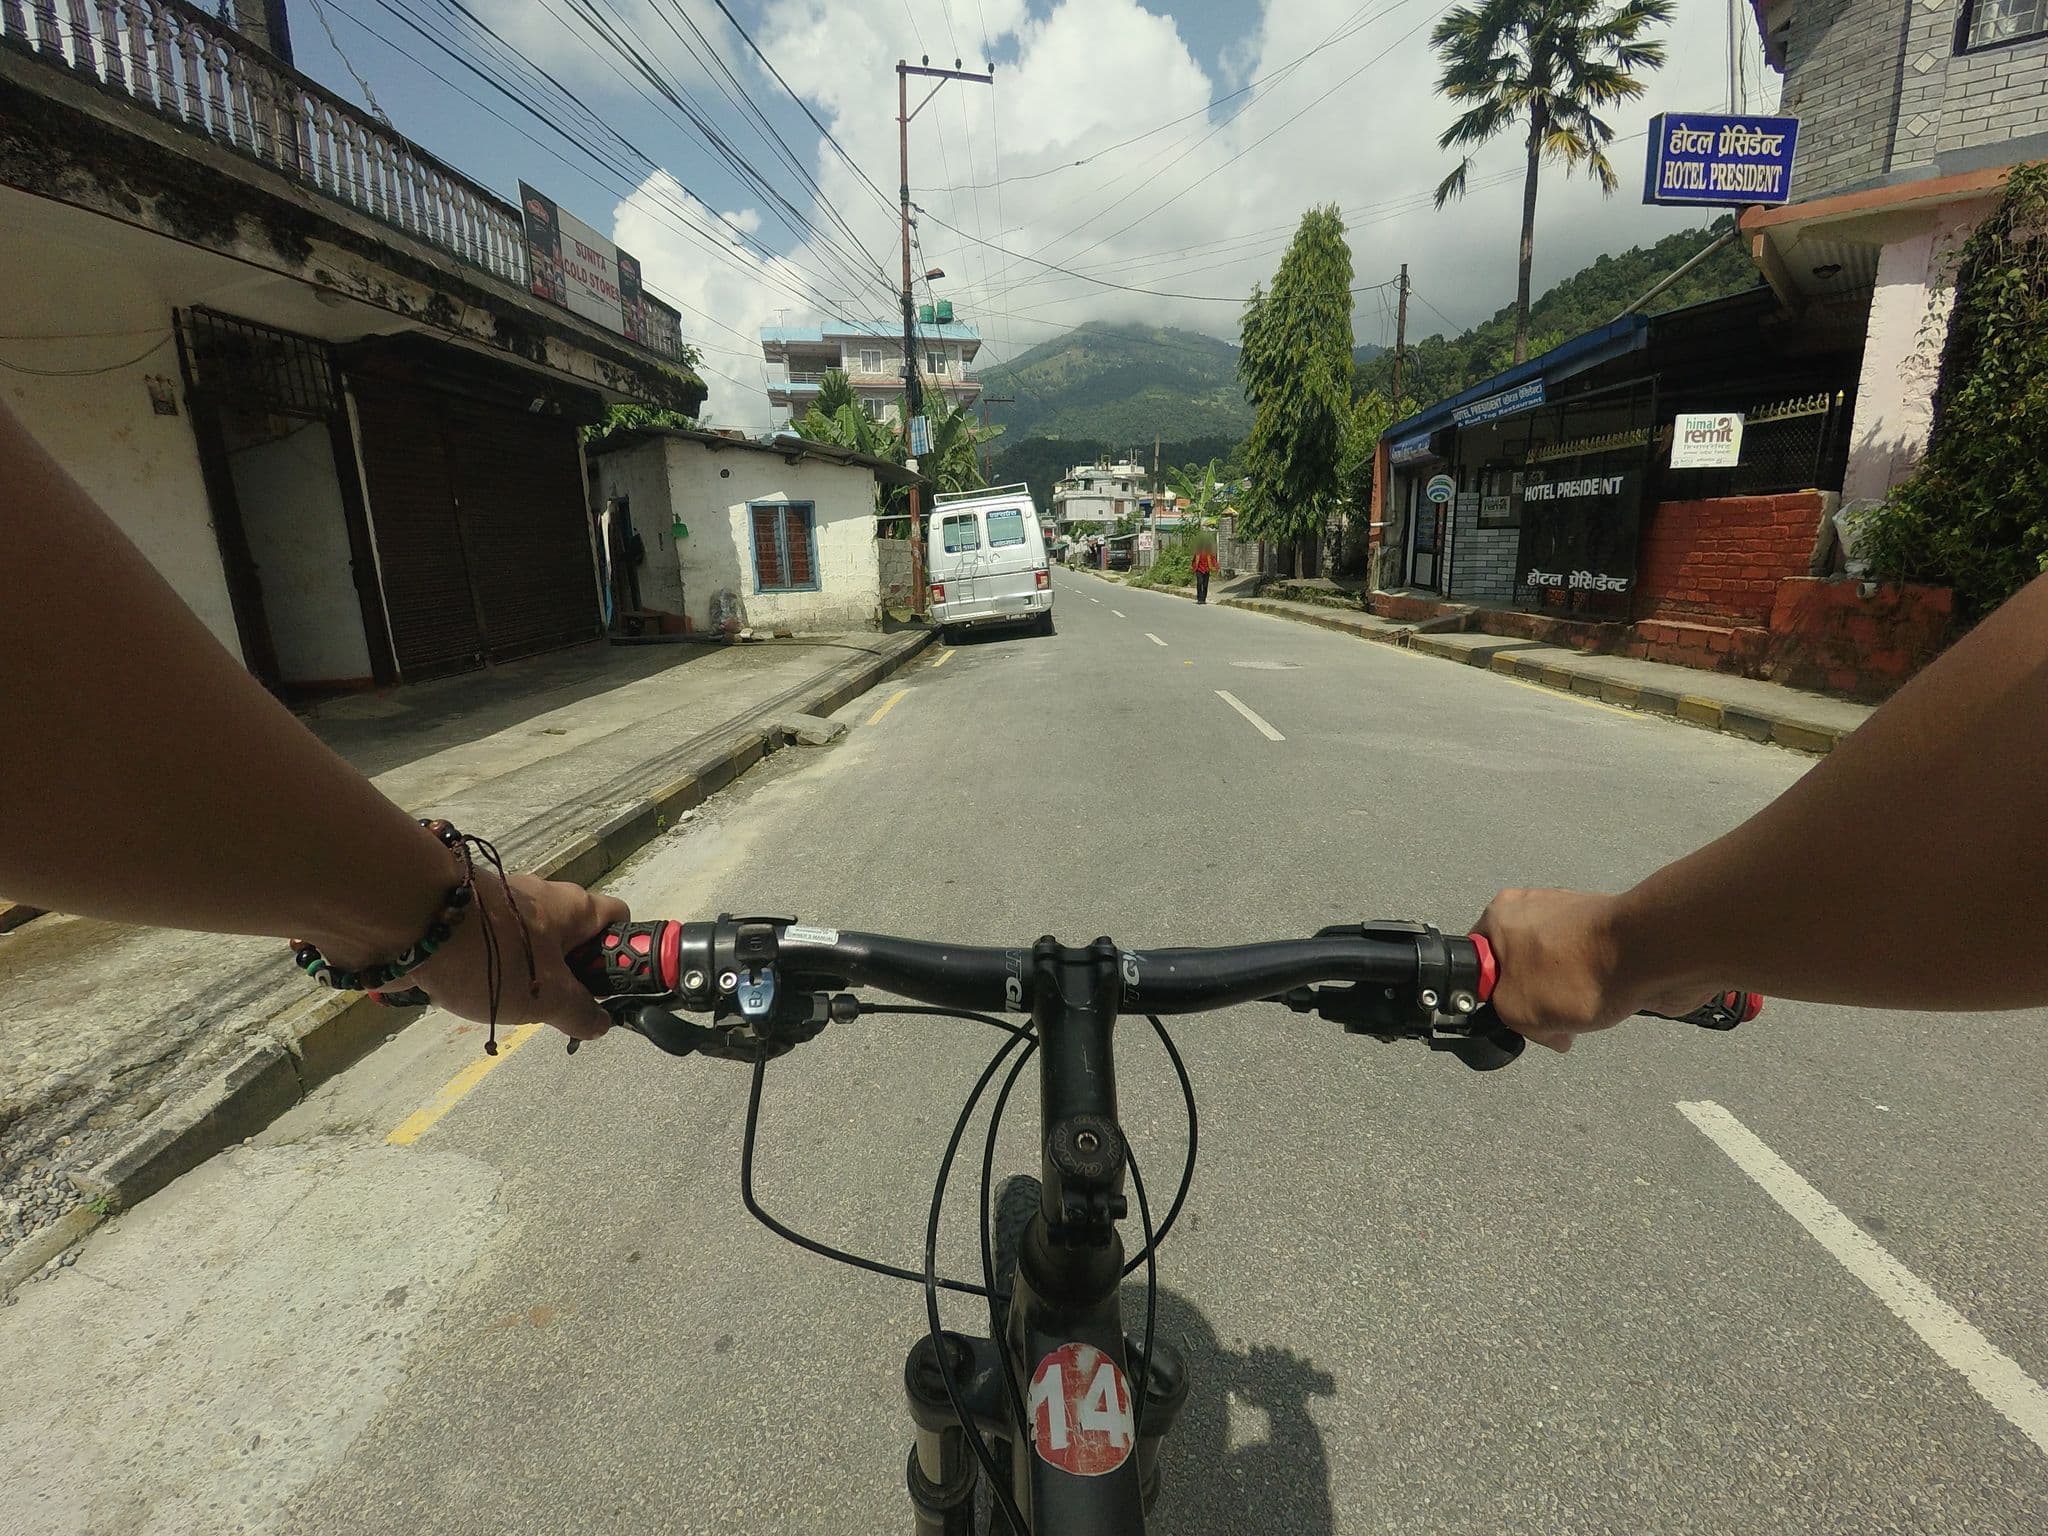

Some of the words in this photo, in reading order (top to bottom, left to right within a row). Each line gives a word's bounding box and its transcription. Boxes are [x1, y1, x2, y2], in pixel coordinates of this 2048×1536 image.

[1669, 122, 1715, 155] होटल
[1718, 123, 1785, 158] प्रेसिडेन्ट
[1663, 160, 1707, 190] HOTEL
[1709, 163, 1783, 193] PRESIDENT
[575, 241, 607, 273] SUNITA
[564, 258, 588, 284] COLD
[589, 273, 621, 302] STORES
[1471, 398, 1502, 415] PRESIDENT
[1684, 423, 1734, 444] remit
[1685, 417, 1717, 430] himal
[1524, 482, 1556, 502] HOTEL
[1556, 476, 1624, 499] PRESIDENT
[1526, 568, 1563, 587] होटल
[1029, 1362, 1129, 1450] 14
